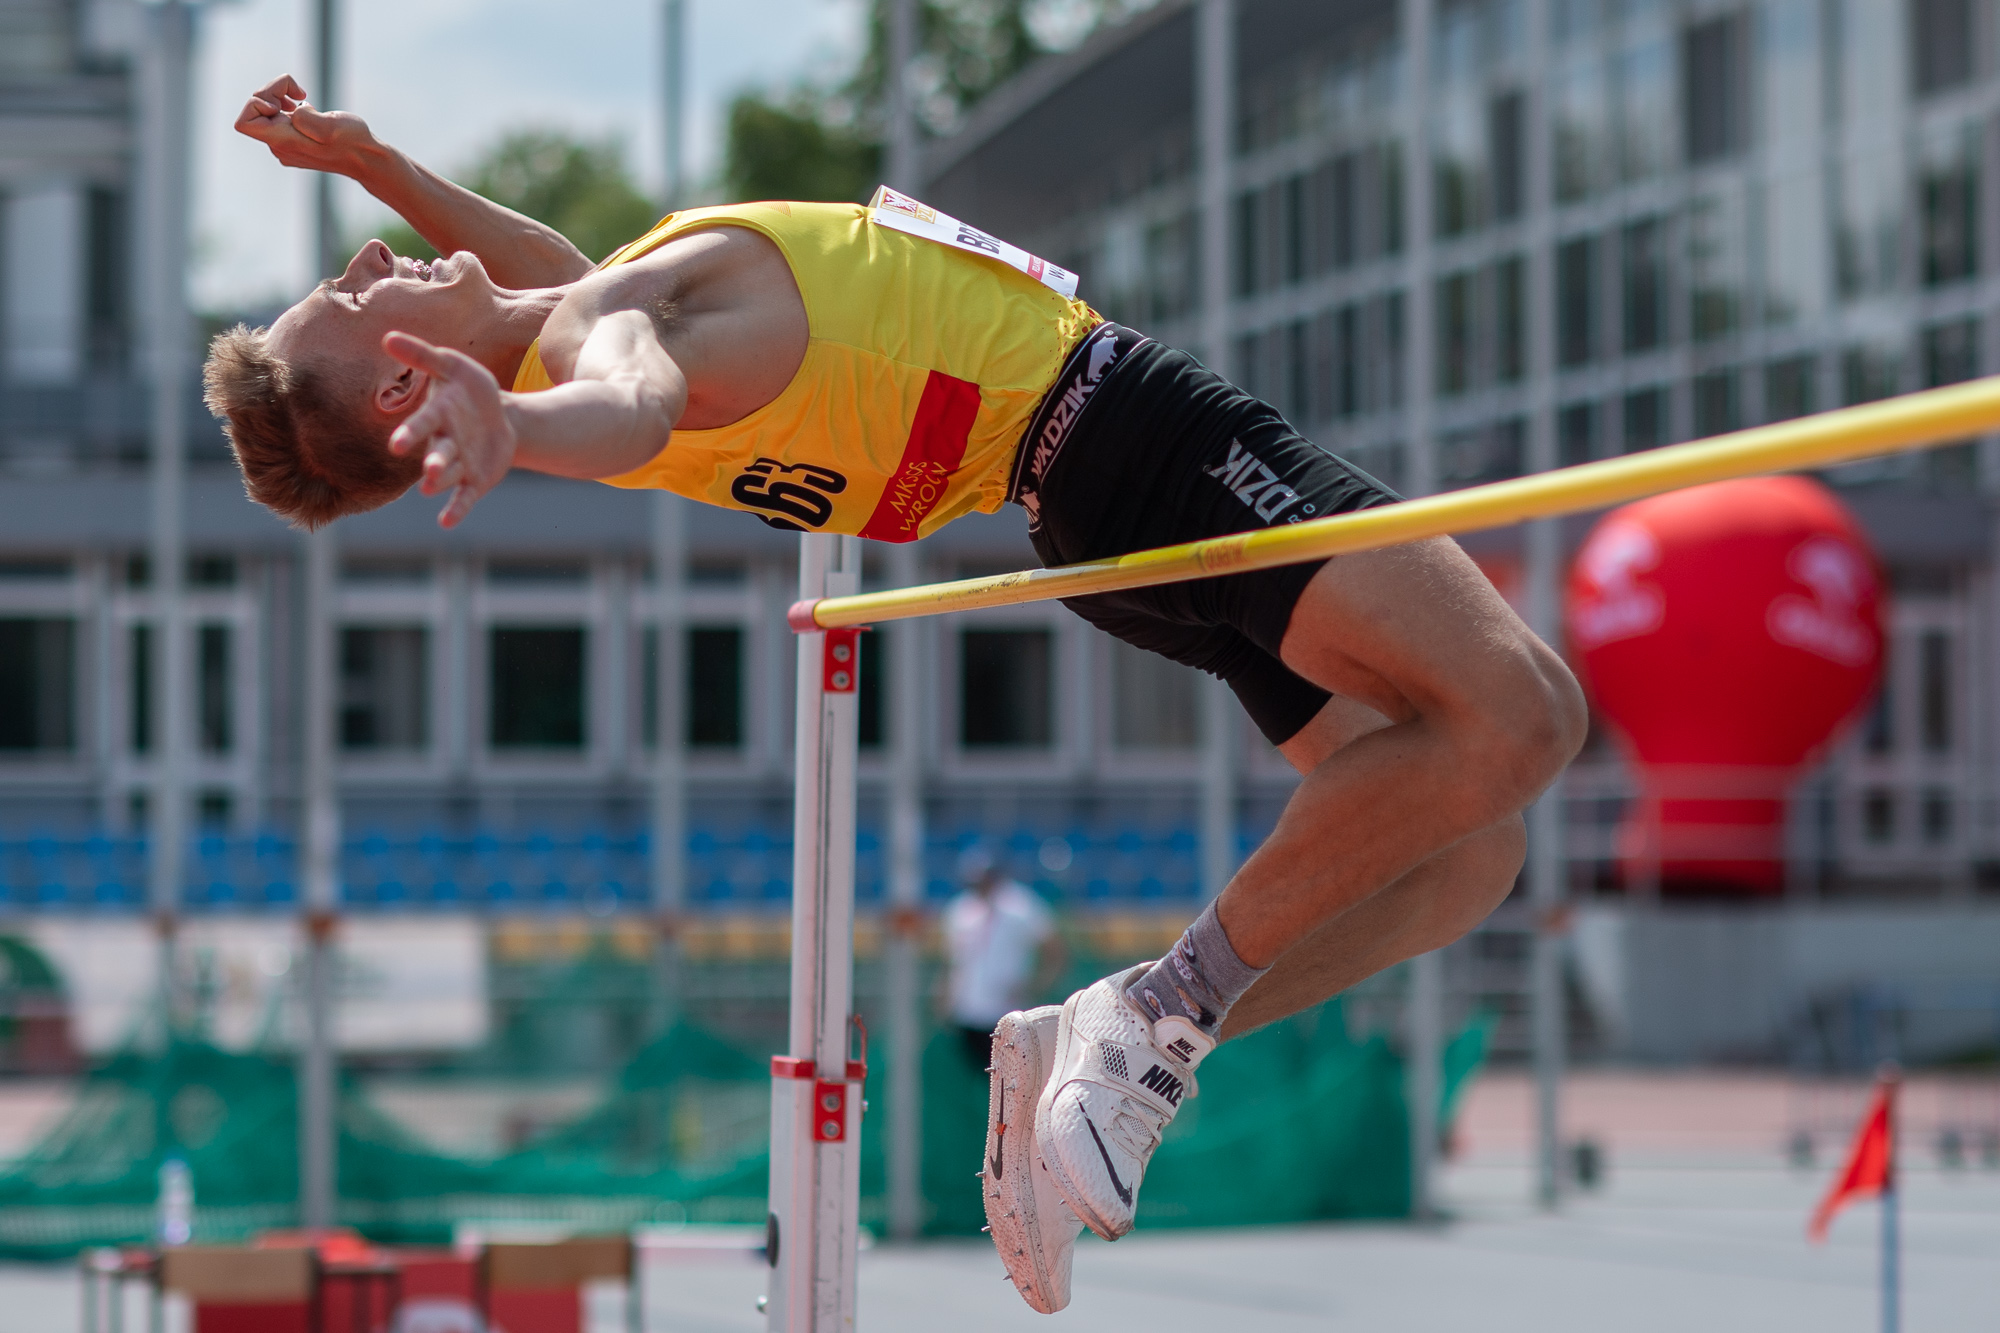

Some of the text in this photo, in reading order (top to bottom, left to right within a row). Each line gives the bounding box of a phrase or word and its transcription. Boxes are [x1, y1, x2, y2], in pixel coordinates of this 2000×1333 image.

[1049, 373, 1095, 448] DZIK
[731, 457, 847, 533] 63
[1207, 437, 1300, 525] DZIK
[1173, 1037, 1197, 1056] NIKE
[1138, 1064, 1184, 1108] NIKE
